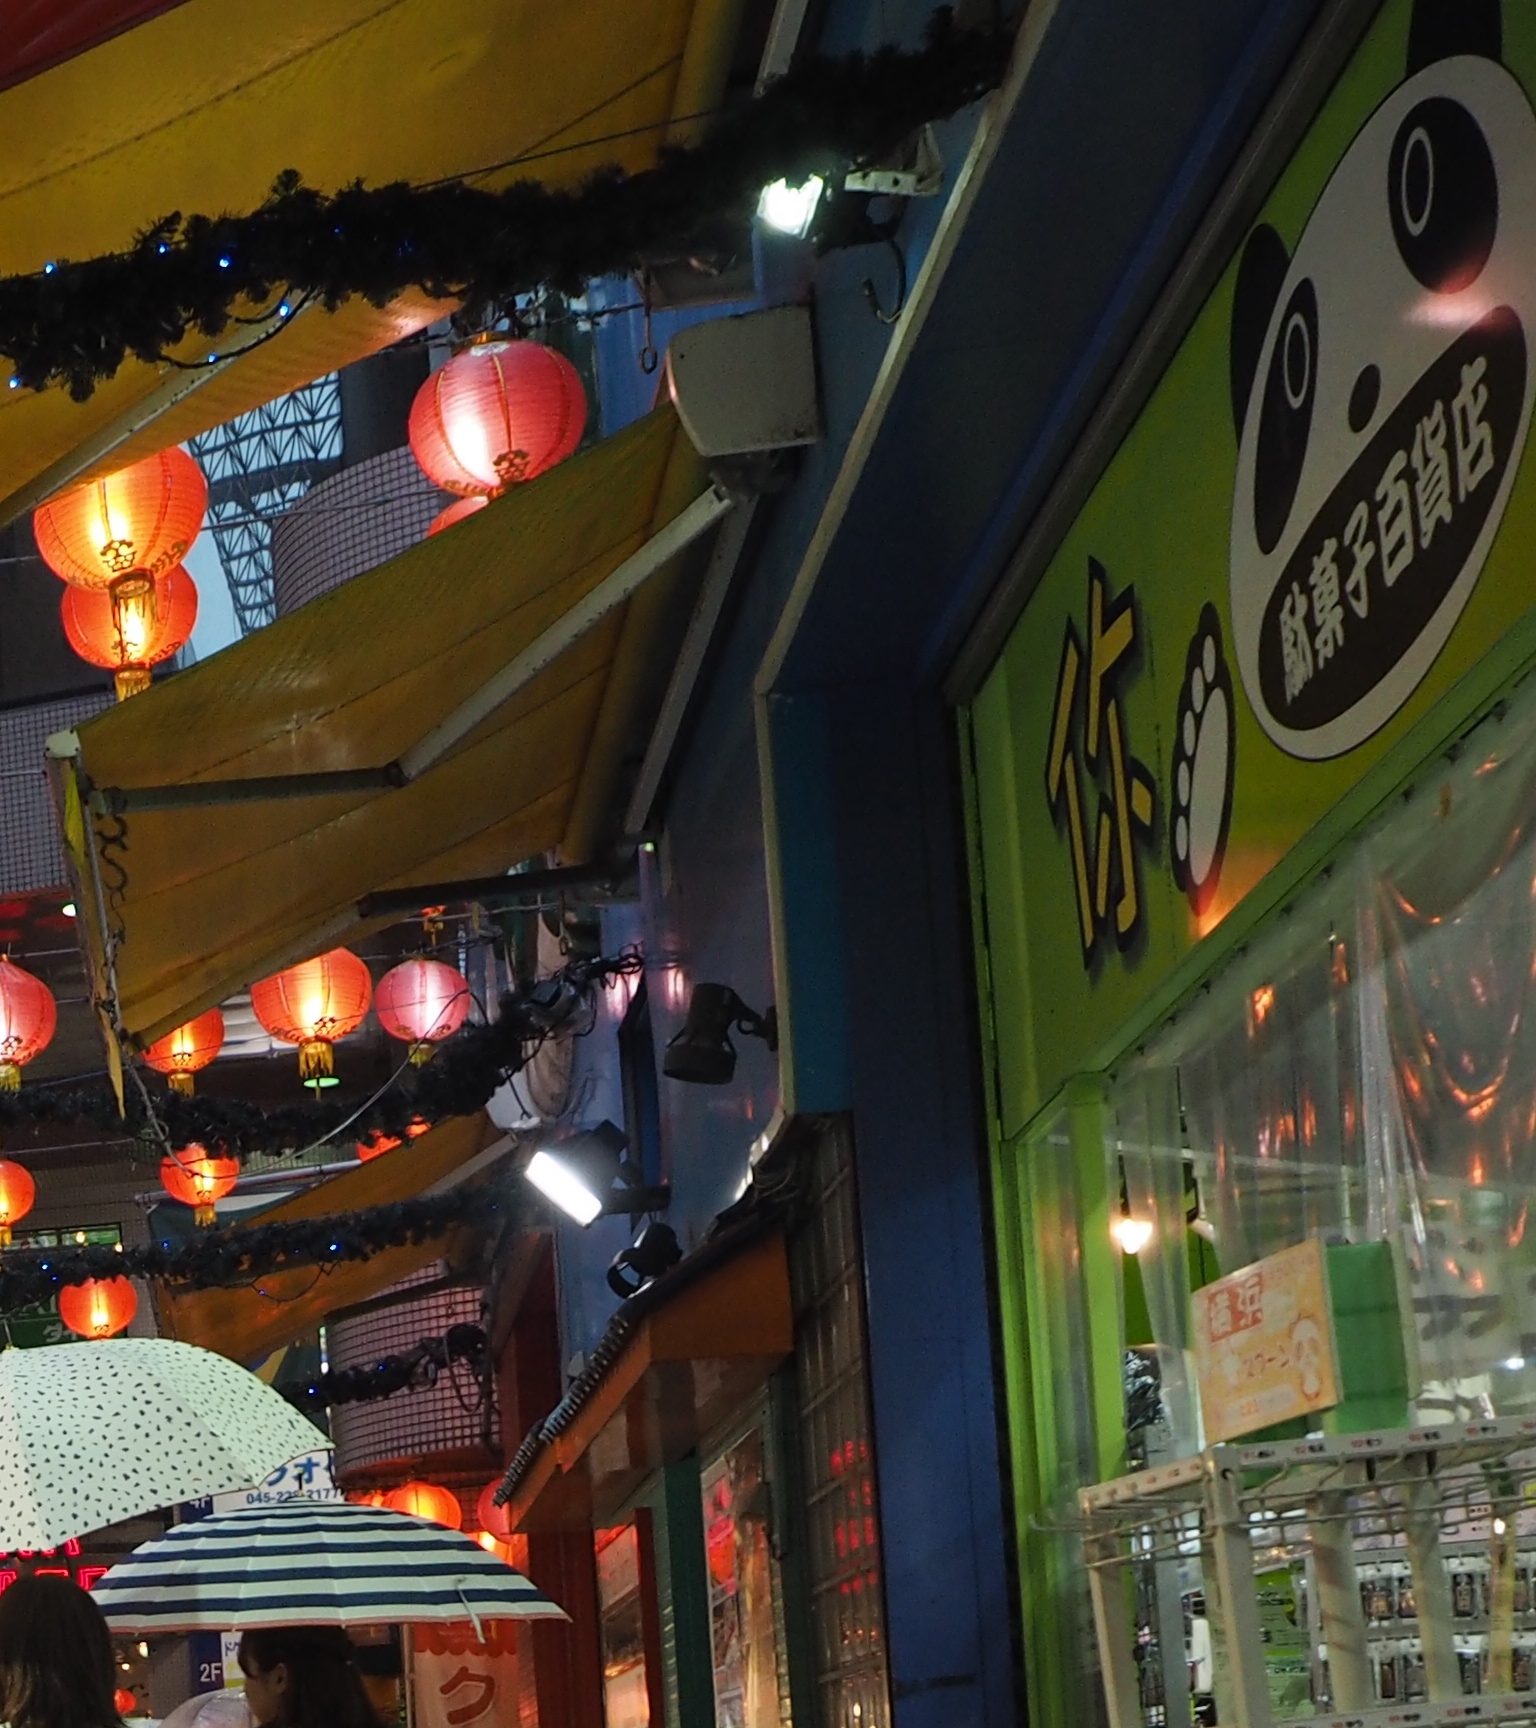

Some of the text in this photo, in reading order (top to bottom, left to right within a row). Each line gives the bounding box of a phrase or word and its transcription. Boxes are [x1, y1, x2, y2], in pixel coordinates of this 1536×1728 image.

[1277, 356, 1495, 706] 駄菓子百貨店
[1045, 556, 1157, 970] 你
[200, 1662, 222, 1682] 2F
